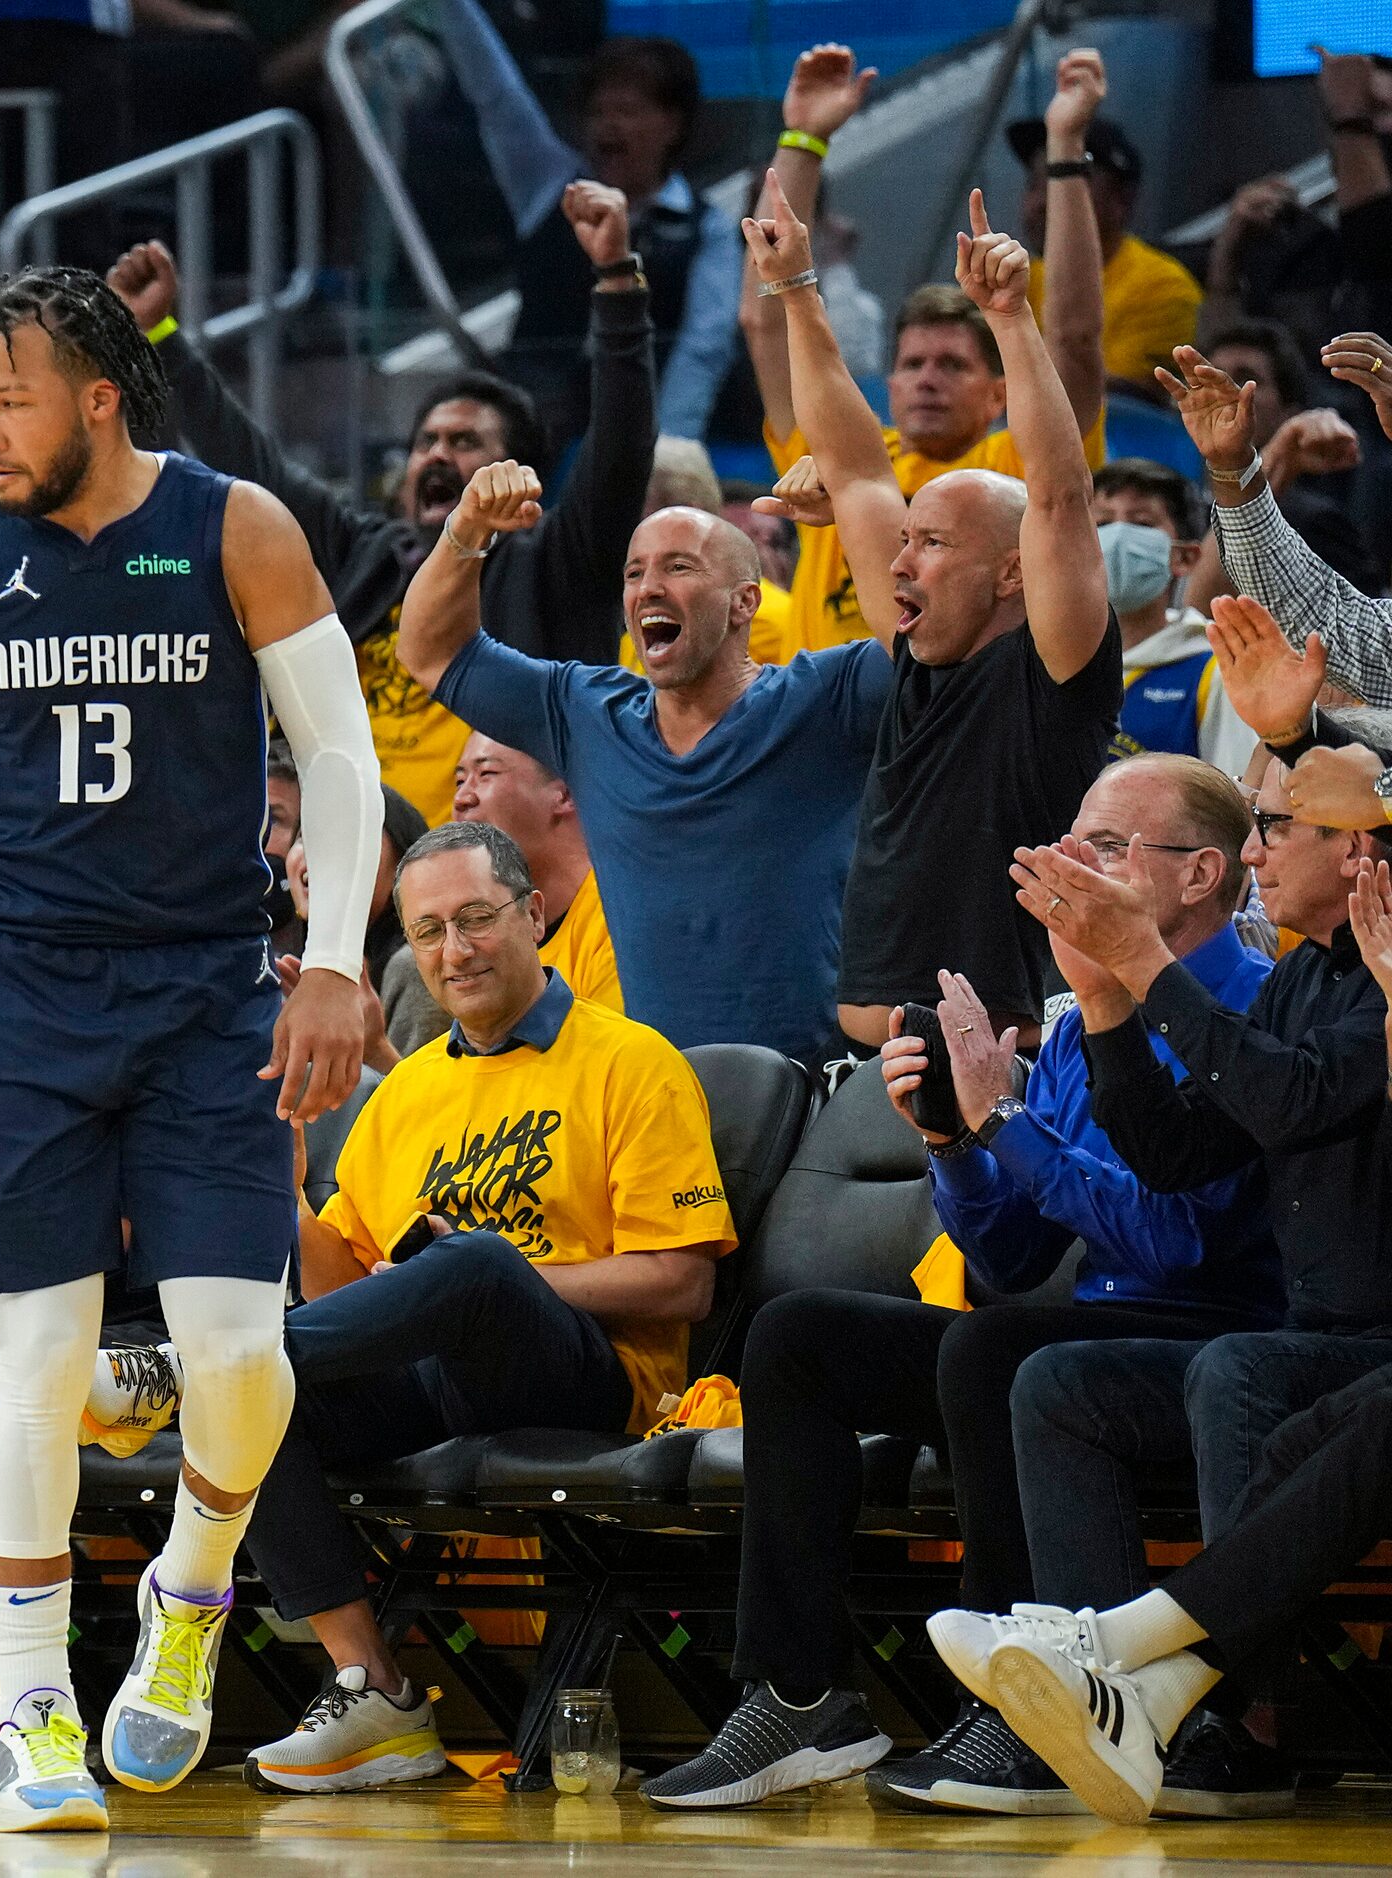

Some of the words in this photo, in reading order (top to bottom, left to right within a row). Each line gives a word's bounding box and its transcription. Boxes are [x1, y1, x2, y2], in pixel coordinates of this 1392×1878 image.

[125, 554, 191, 576] chime
[51, 702, 133, 804] 13
[671, 1185, 725, 1209] Raku
